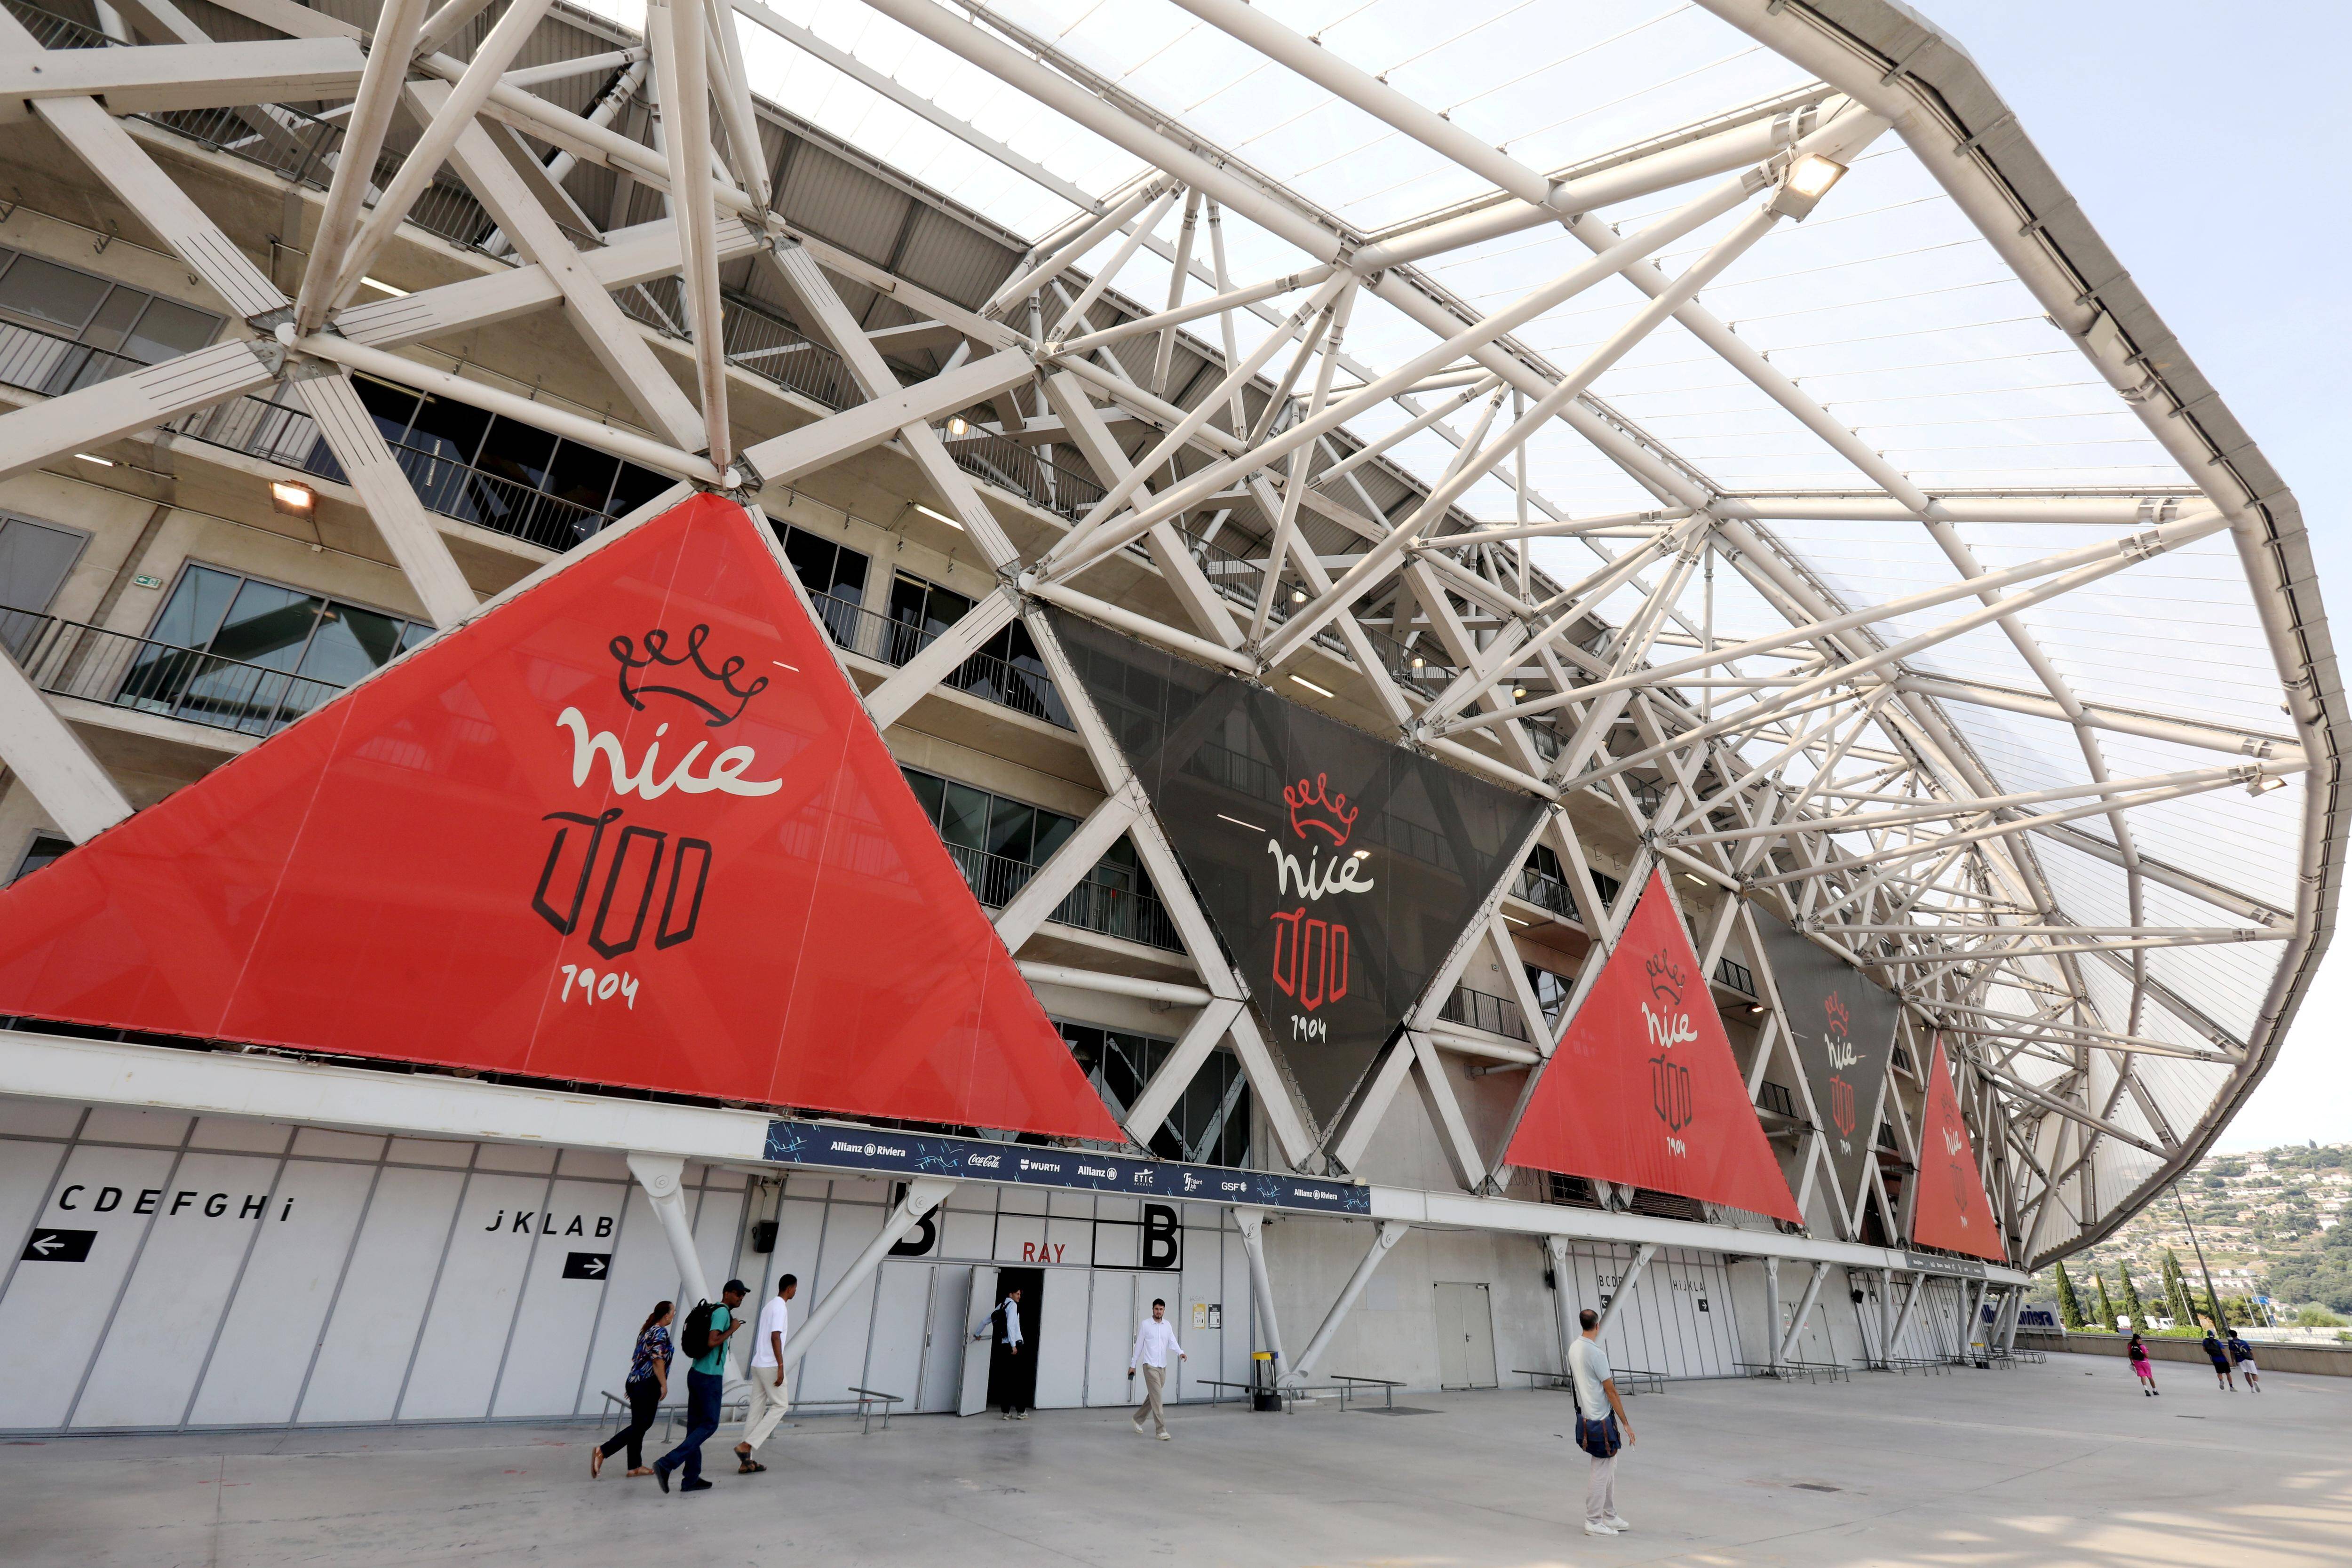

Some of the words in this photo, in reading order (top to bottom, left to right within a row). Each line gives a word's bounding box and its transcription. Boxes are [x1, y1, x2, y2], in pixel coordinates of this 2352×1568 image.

[561, 964, 639, 1010] 1904
[1291, 1014, 1327, 1043] 1904
[830, 1141, 863, 1153] Allianz
[877, 1146, 906, 1157] Riviera
[1667, 1136, 1685, 1159] 1904
[1031, 1162, 1060, 1172] WÜRTH
[1077, 1165, 1105, 1177] Allianz
[1134, 1174, 1153, 1183] ETIC
[1221, 1182, 1240, 1191] GSF
[1294, 1188, 1312, 1197] Allianz
[1320, 1192, 1337, 1200] Riviera
[1143, 1203, 1177, 1268] B
[1023, 1242, 1066, 1263] RAY
